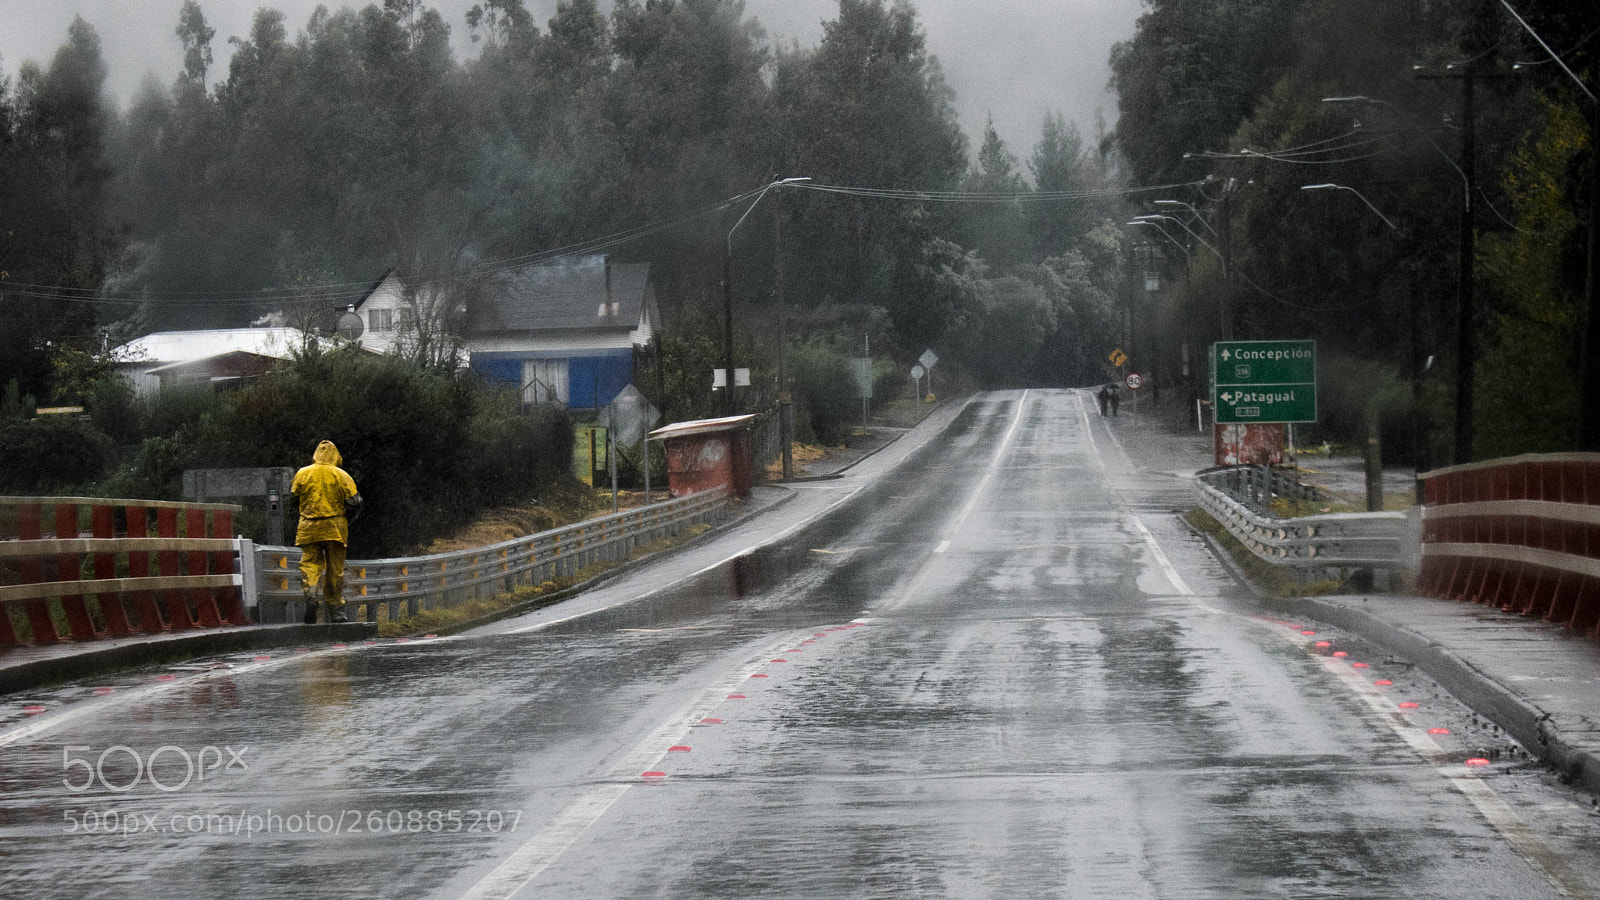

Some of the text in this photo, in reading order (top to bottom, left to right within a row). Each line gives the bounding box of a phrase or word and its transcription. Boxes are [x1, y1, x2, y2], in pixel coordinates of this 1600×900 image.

[1235, 347, 1312, 361] Concepción
[1128, 376, 1140, 386] 80
[1235, 390, 1296, 404] Patagual
